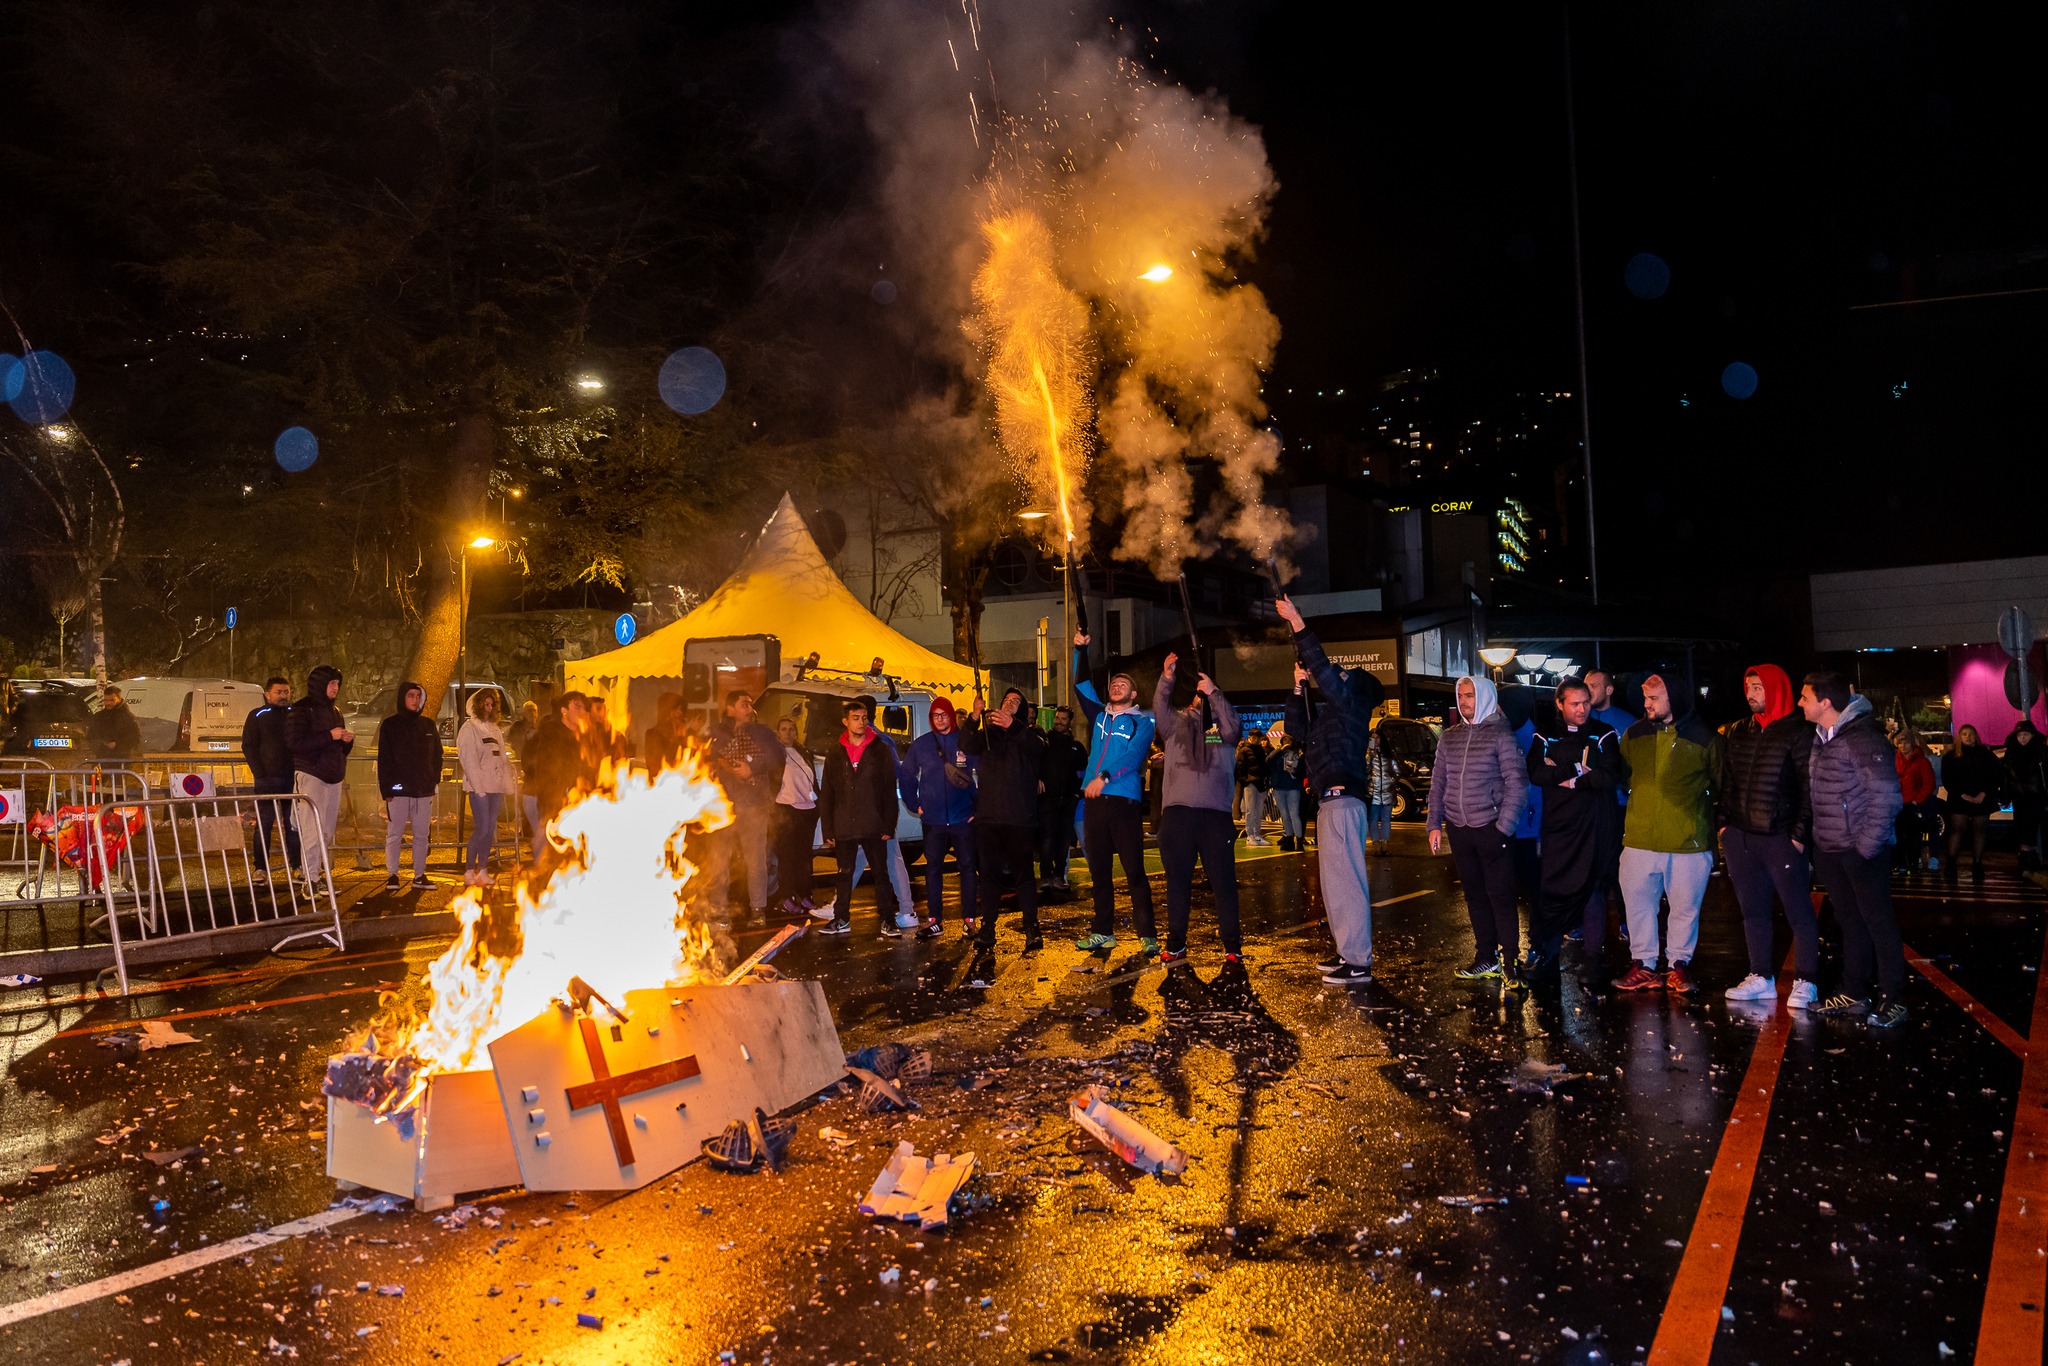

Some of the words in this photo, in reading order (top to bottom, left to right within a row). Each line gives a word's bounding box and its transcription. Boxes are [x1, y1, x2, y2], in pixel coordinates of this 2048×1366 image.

[1431, 501, 1473, 513] CORAY
[1327, 653, 1380, 664] ESTAURANT
[1237, 711, 1286, 721] ESTAURANT
